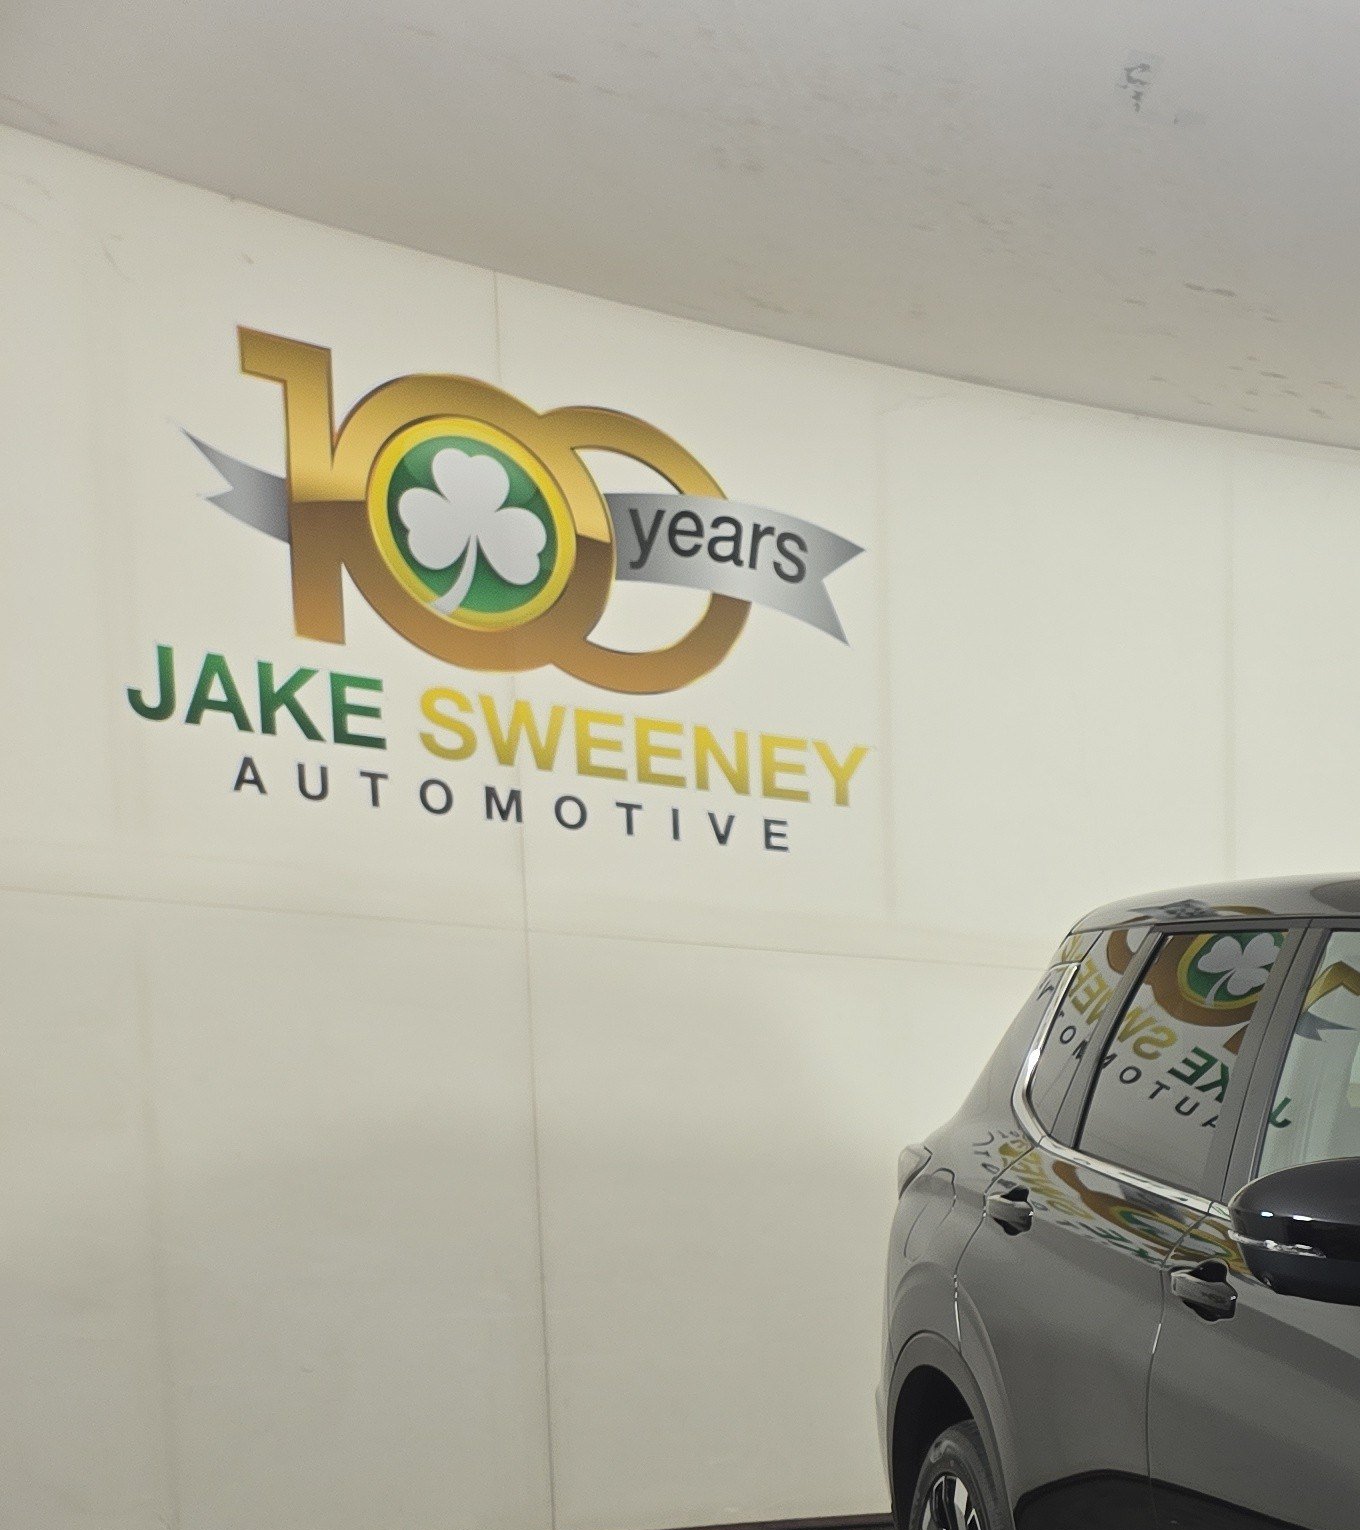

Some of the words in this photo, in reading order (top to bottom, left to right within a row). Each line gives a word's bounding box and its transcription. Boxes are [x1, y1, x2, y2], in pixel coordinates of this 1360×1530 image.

[236, 326, 751, 695] 100
[628, 504, 809, 584] years
[127, 644, 388, 750] JAKE
[418, 686, 870, 806] SWEENEY
[233, 757, 791, 853] AUTOMOTIVE
